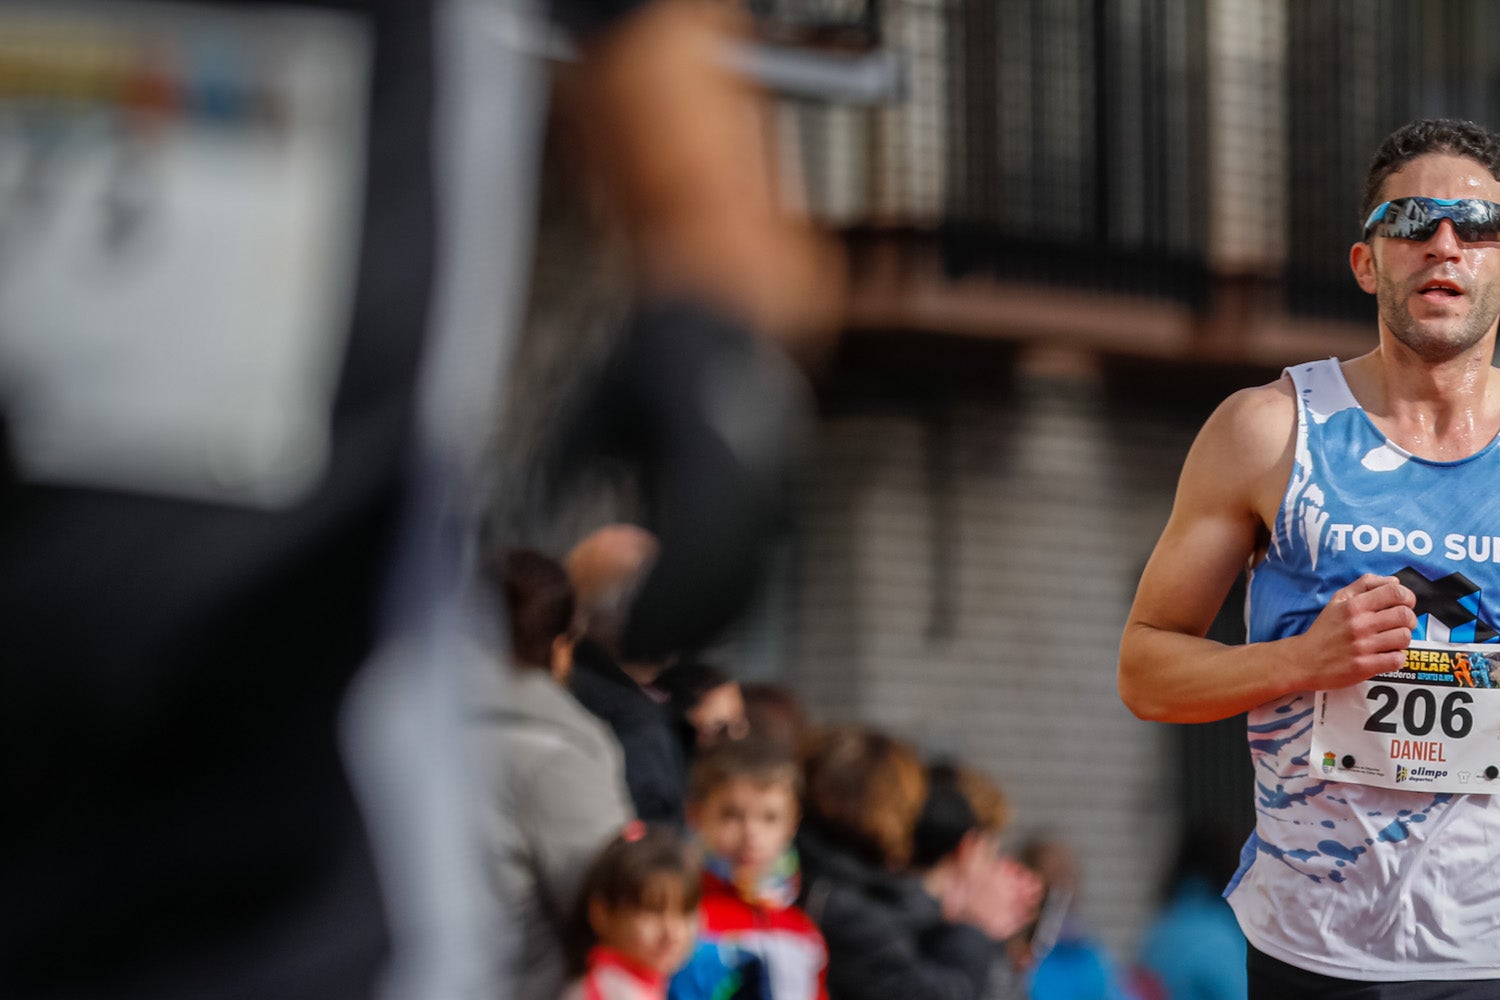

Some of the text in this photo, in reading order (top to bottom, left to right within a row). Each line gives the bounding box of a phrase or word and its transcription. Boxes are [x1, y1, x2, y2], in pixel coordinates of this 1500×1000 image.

[1330, 523, 1433, 556] TODO
[1400, 649, 1450, 664] RRERA
[1403, 660, 1450, 673] PULAR
[1363, 685, 1474, 739] 206
[1390, 739, 1447, 762] DANIEL
[1411, 767, 1448, 779] olimpo
